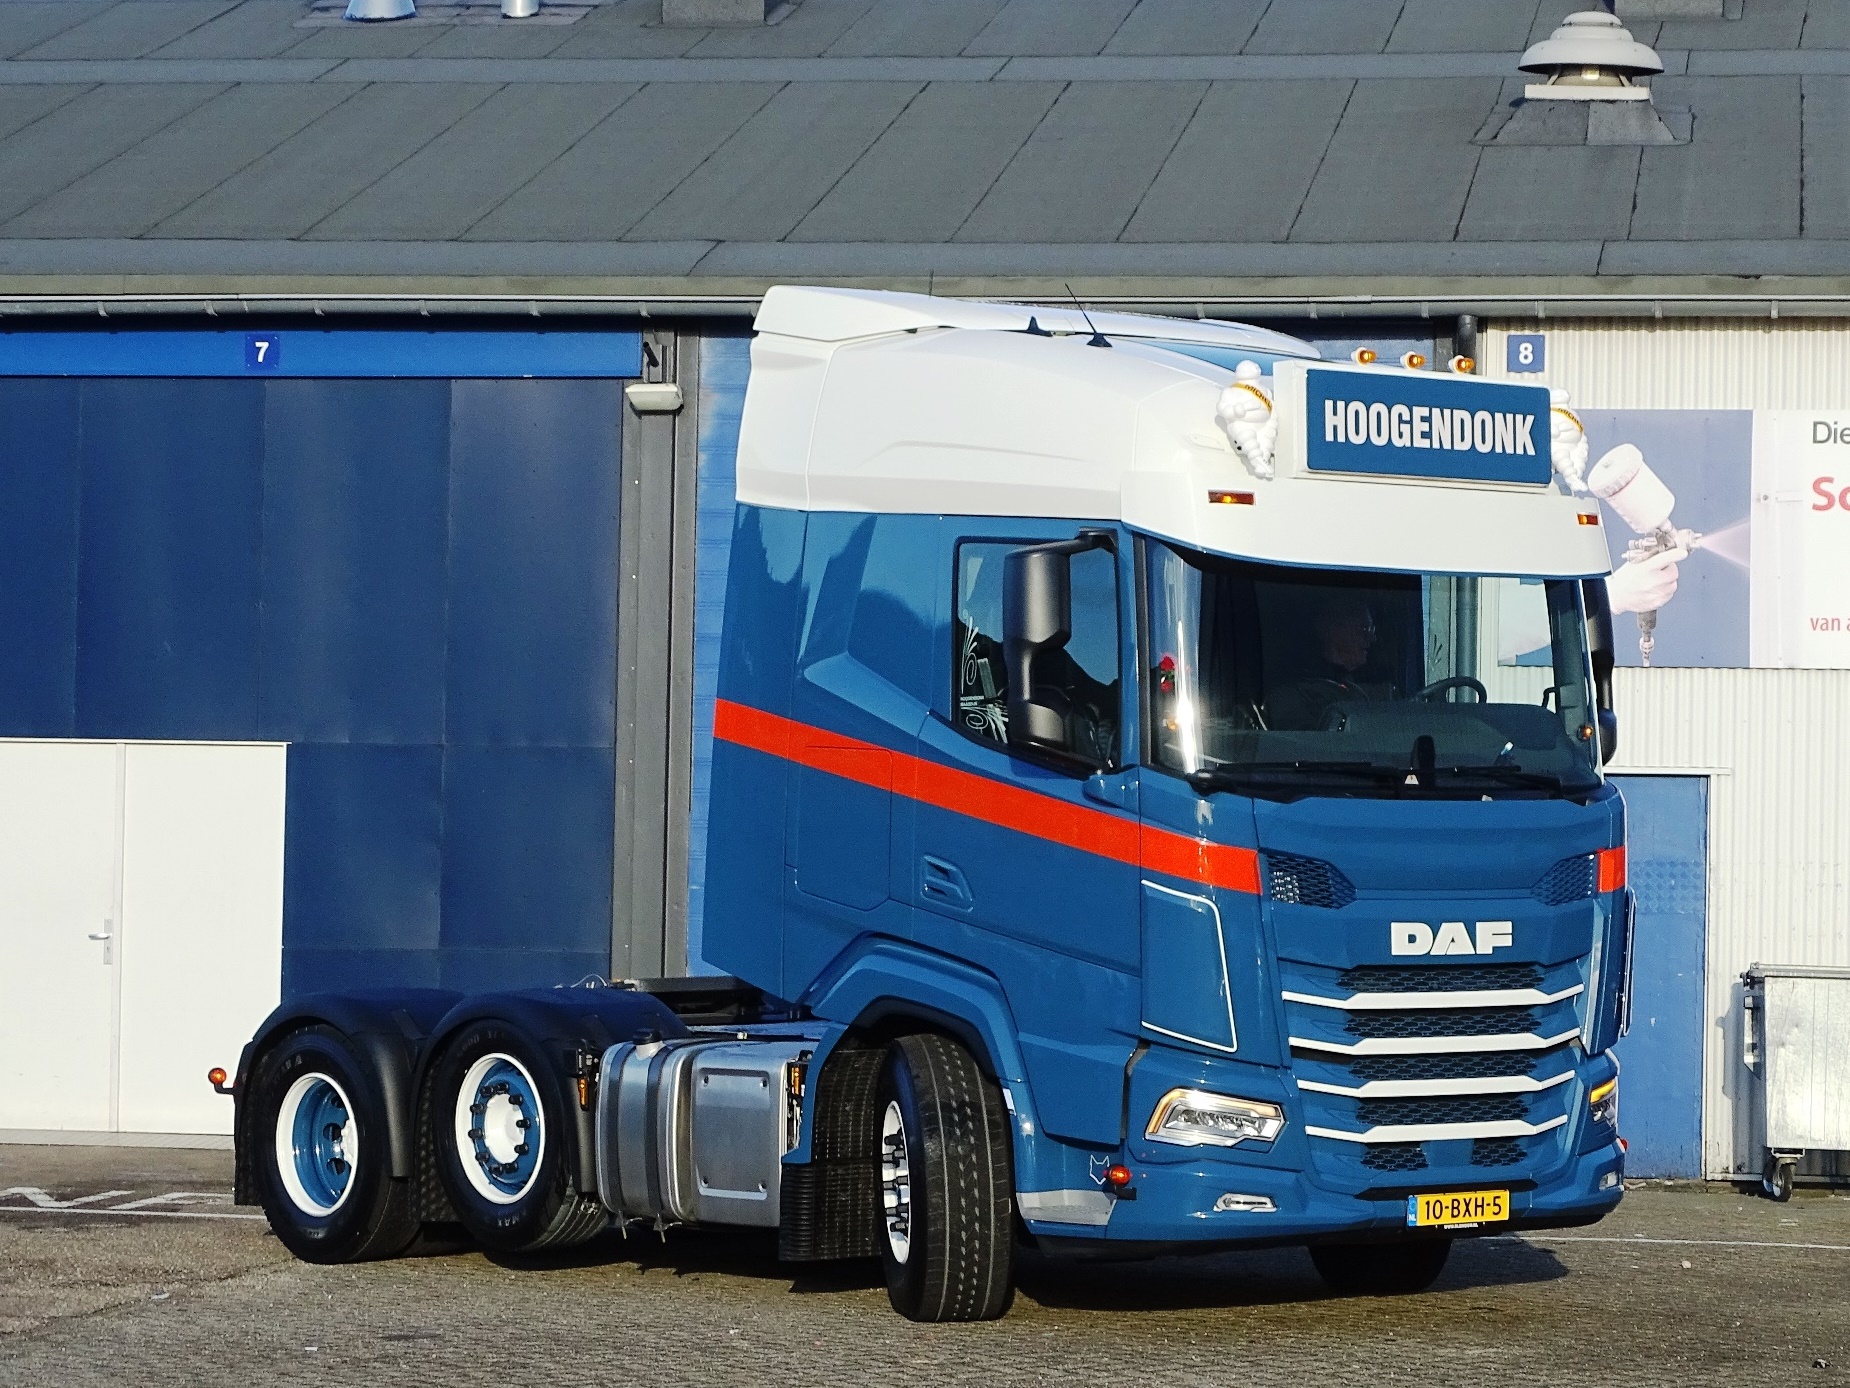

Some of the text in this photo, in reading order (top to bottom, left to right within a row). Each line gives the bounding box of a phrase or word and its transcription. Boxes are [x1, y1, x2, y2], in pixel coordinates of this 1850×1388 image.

[254, 341, 269, 363] 7
[1518, 342, 1534, 365] 8
[1324, 399, 1536, 456] HOOGENDONK
[1810, 617, 1841, 632] van
[1390, 920, 1513, 956] DAF
[1408, 1213, 1417, 1221] NL
[1424, 1195, 1502, 1221] 10-BXH-5
